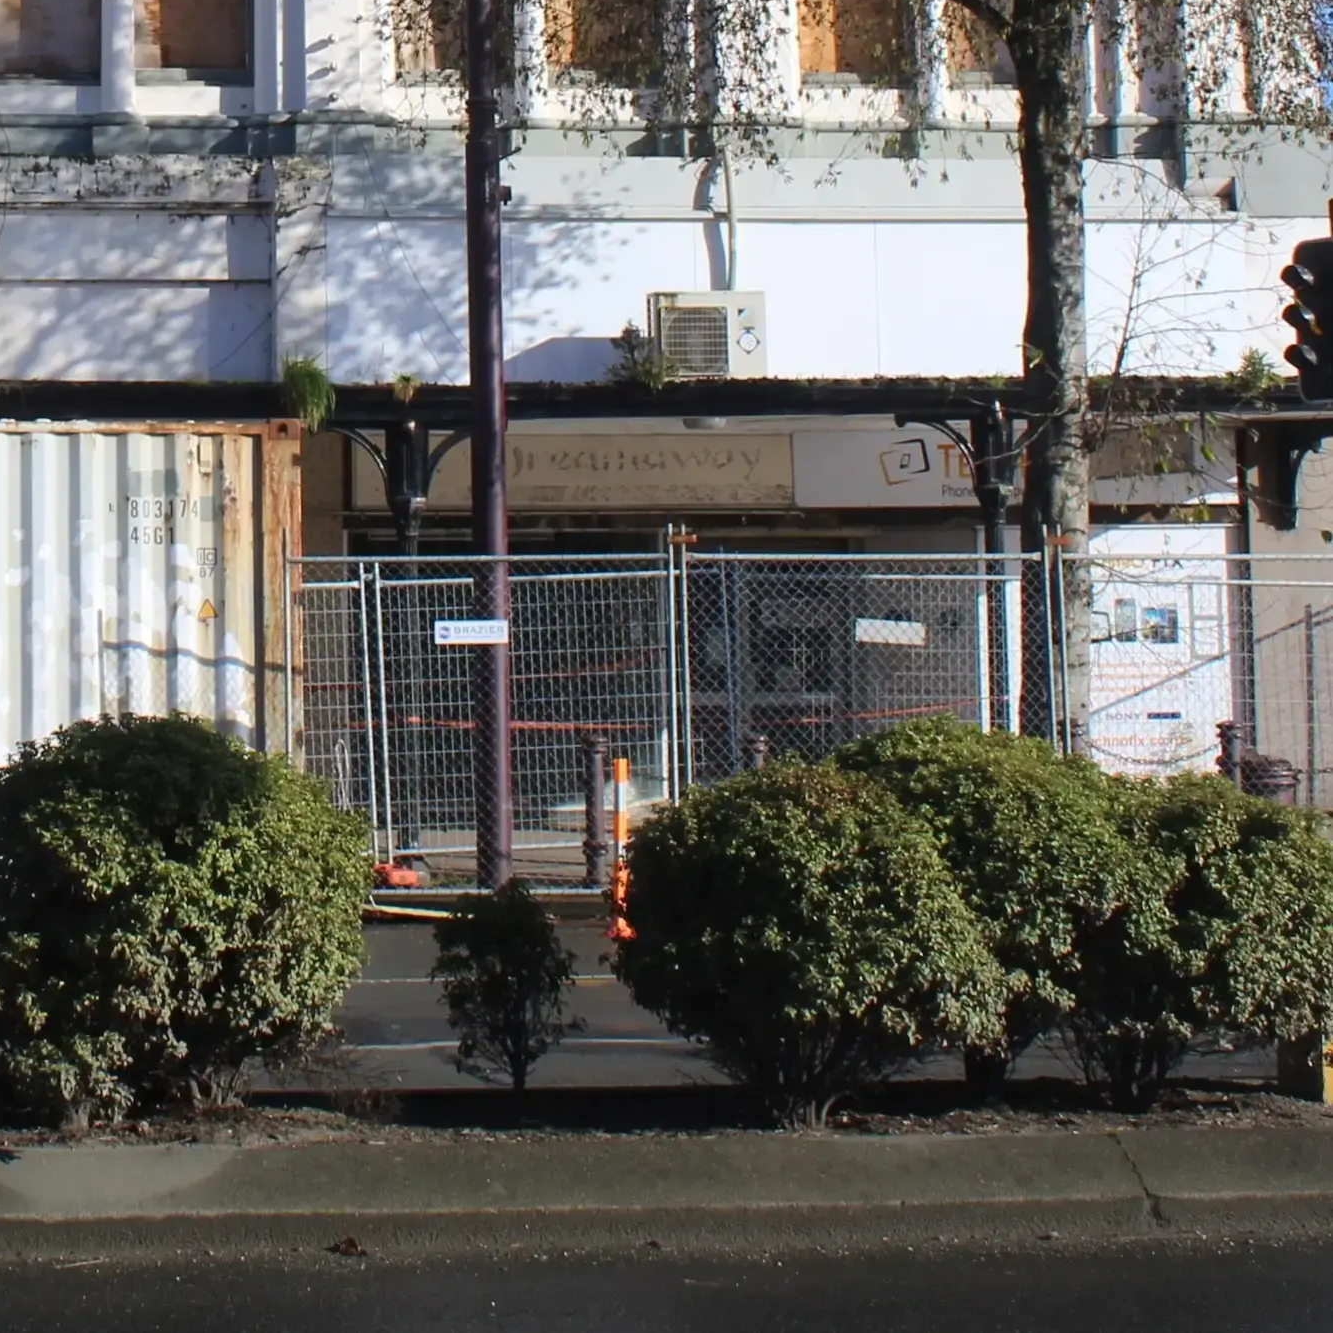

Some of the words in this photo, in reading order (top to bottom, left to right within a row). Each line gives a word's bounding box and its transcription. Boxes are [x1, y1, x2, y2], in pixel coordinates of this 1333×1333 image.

[130, 499, 199, 519] 803174
[130, 526, 175, 546] 45G1
[453, 625, 504, 635] BRAZIER
